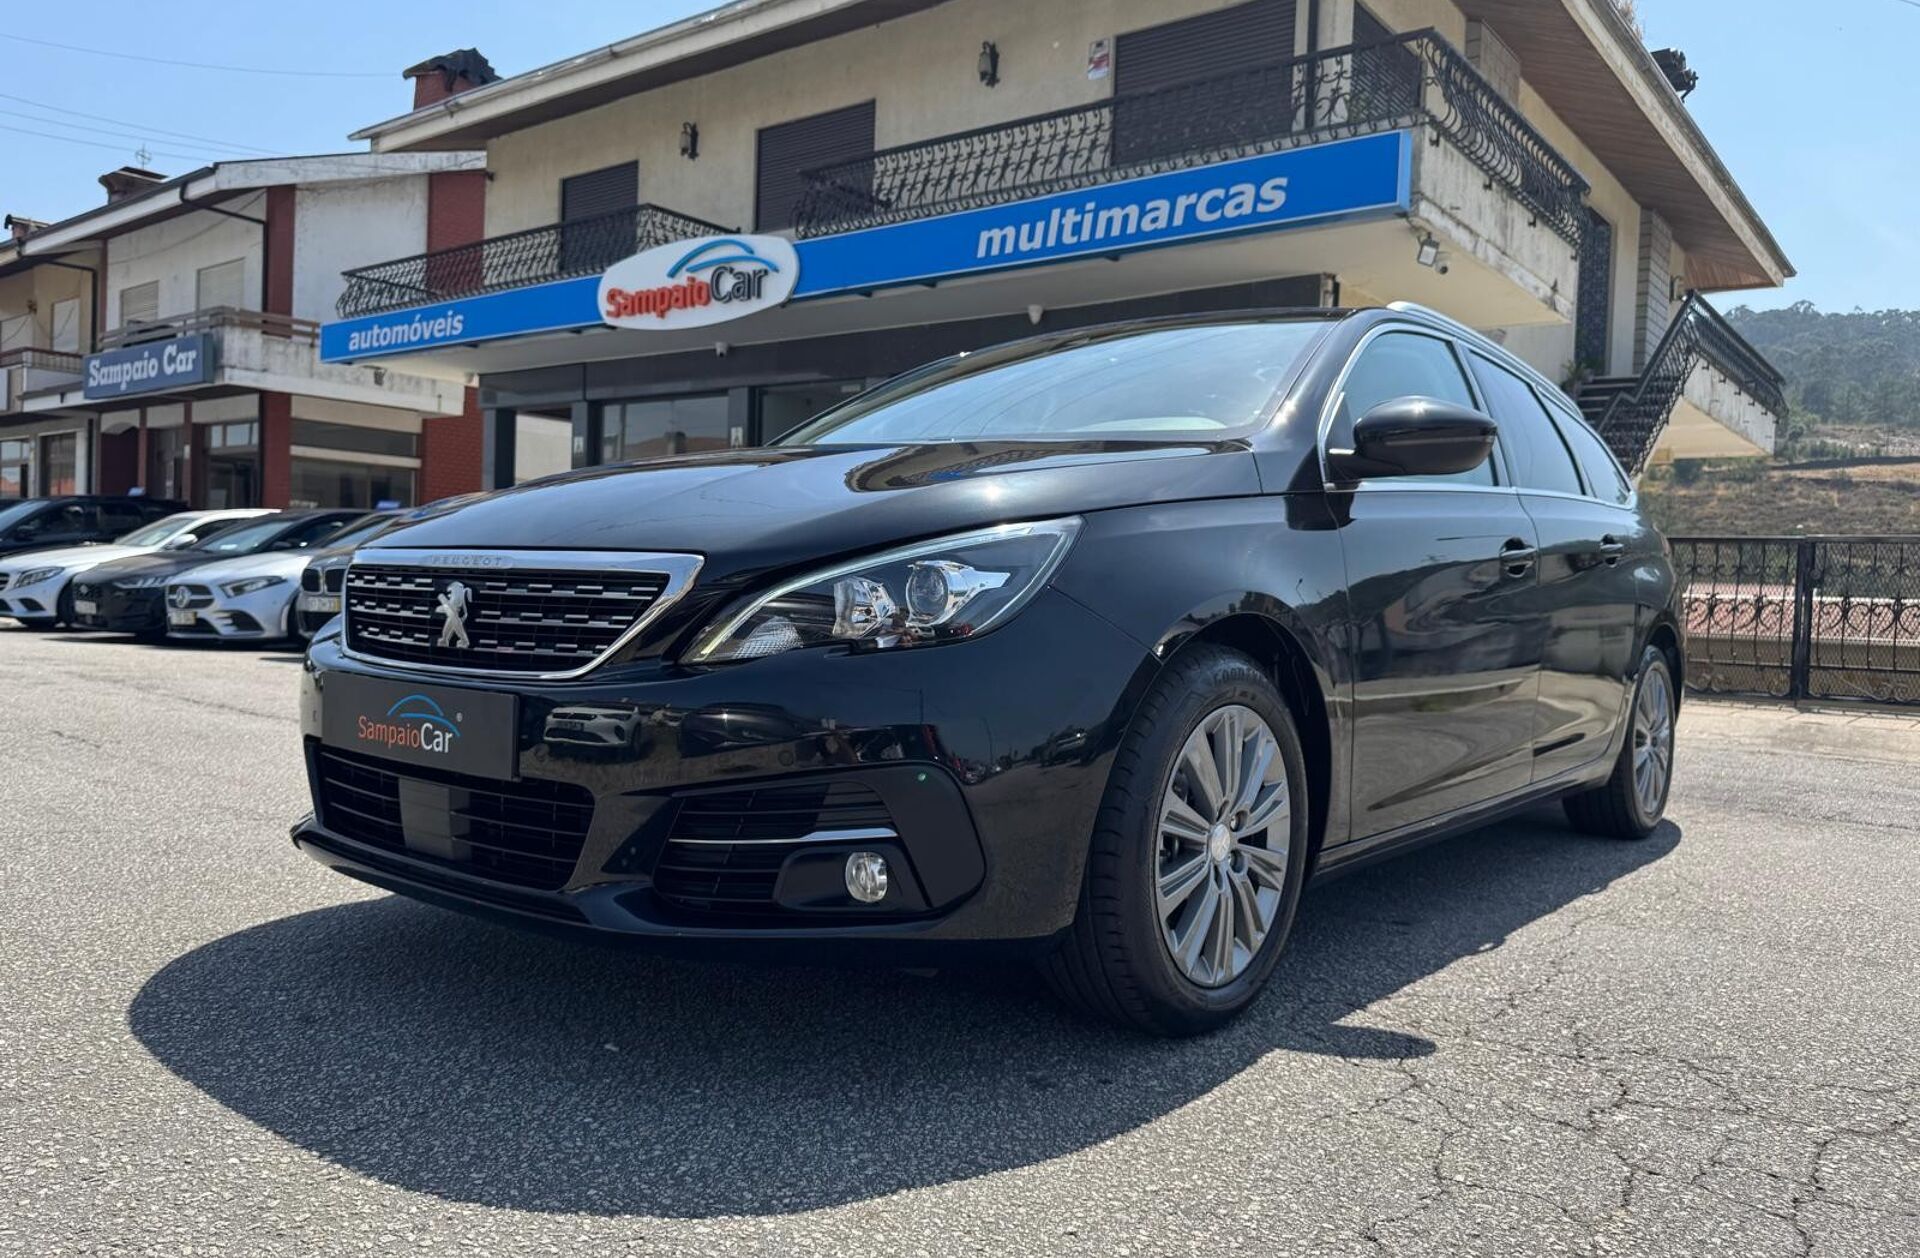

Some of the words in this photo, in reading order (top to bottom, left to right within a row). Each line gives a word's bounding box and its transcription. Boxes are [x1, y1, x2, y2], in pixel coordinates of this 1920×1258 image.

[976, 176, 1288, 258] multimarcas
[348, 309, 464, 351] automóveis
[88, 351, 158, 391] Sampaio
[163, 344, 197, 375] Car
[431, 554, 502, 567] PEUGEOT
